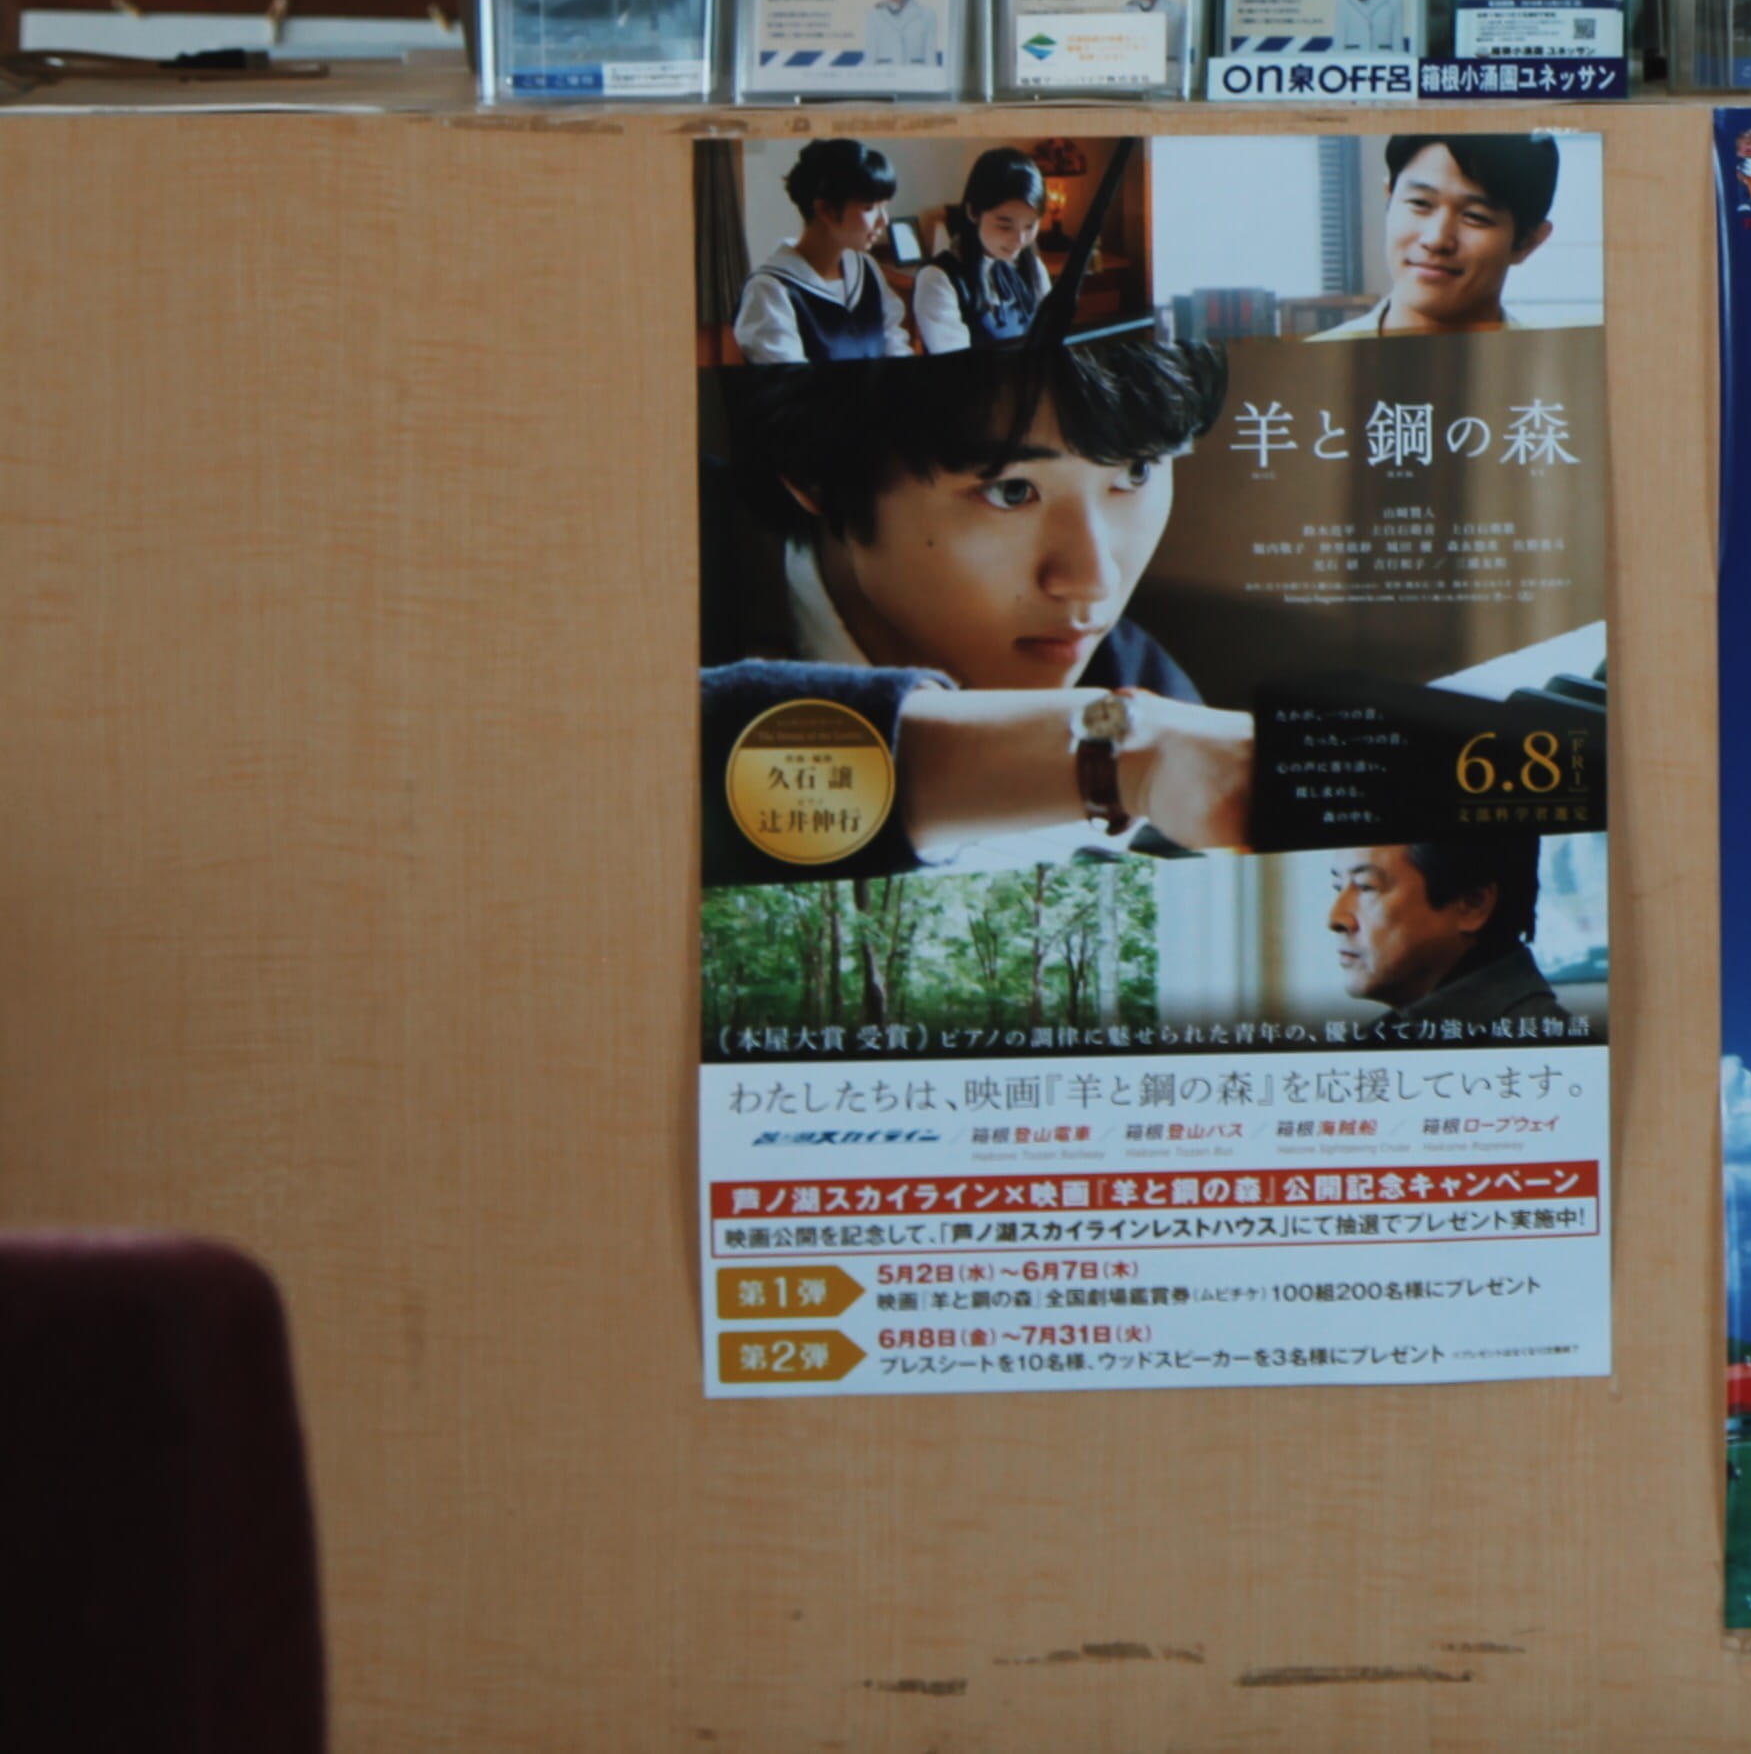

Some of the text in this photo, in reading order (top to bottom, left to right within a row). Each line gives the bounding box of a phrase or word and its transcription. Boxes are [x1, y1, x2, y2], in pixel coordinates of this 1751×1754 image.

[1223, 64, 1411, 93] on泉OFF呂
[1421, 64, 1617, 91] 箱根小涌園ユネッサン
[1229, 399, 1581, 468] 羊と鋼の森
[1456, 731, 1561, 793] 6.8
[759, 808, 860, 833] 辻井伸行
[728, 1064, 1584, 1114] わたしたちは、映画『羊と鋼の森』を応援しています。
[972, 1125, 1091, 1143] 箱根登山電車
[1126, 1123, 1243, 1141] 箱根登山バス
[1277, 1119, 1378, 1137] 箱根海賊船
[1423, 1116, 1559, 1135] 箱根ロープウェイ
[732, 1169, 1579, 1214] 芦ノ湖スカイライン×映画『羊と鋼の森』公開記念キャンペーン
[724, 1208, 1585, 1248] 映画公開を記念して、「芦ノ湖スカイラインレストハウス」にて抽選でプレゼント実施中!
[738, 1277, 826, 1308] 第1弾
[739, 1341, 828, 1373] 第2弾
[879, 1347, 1444, 1376] プレスシートを10名様、ウッドスピーカーを3名様にプレゼント
